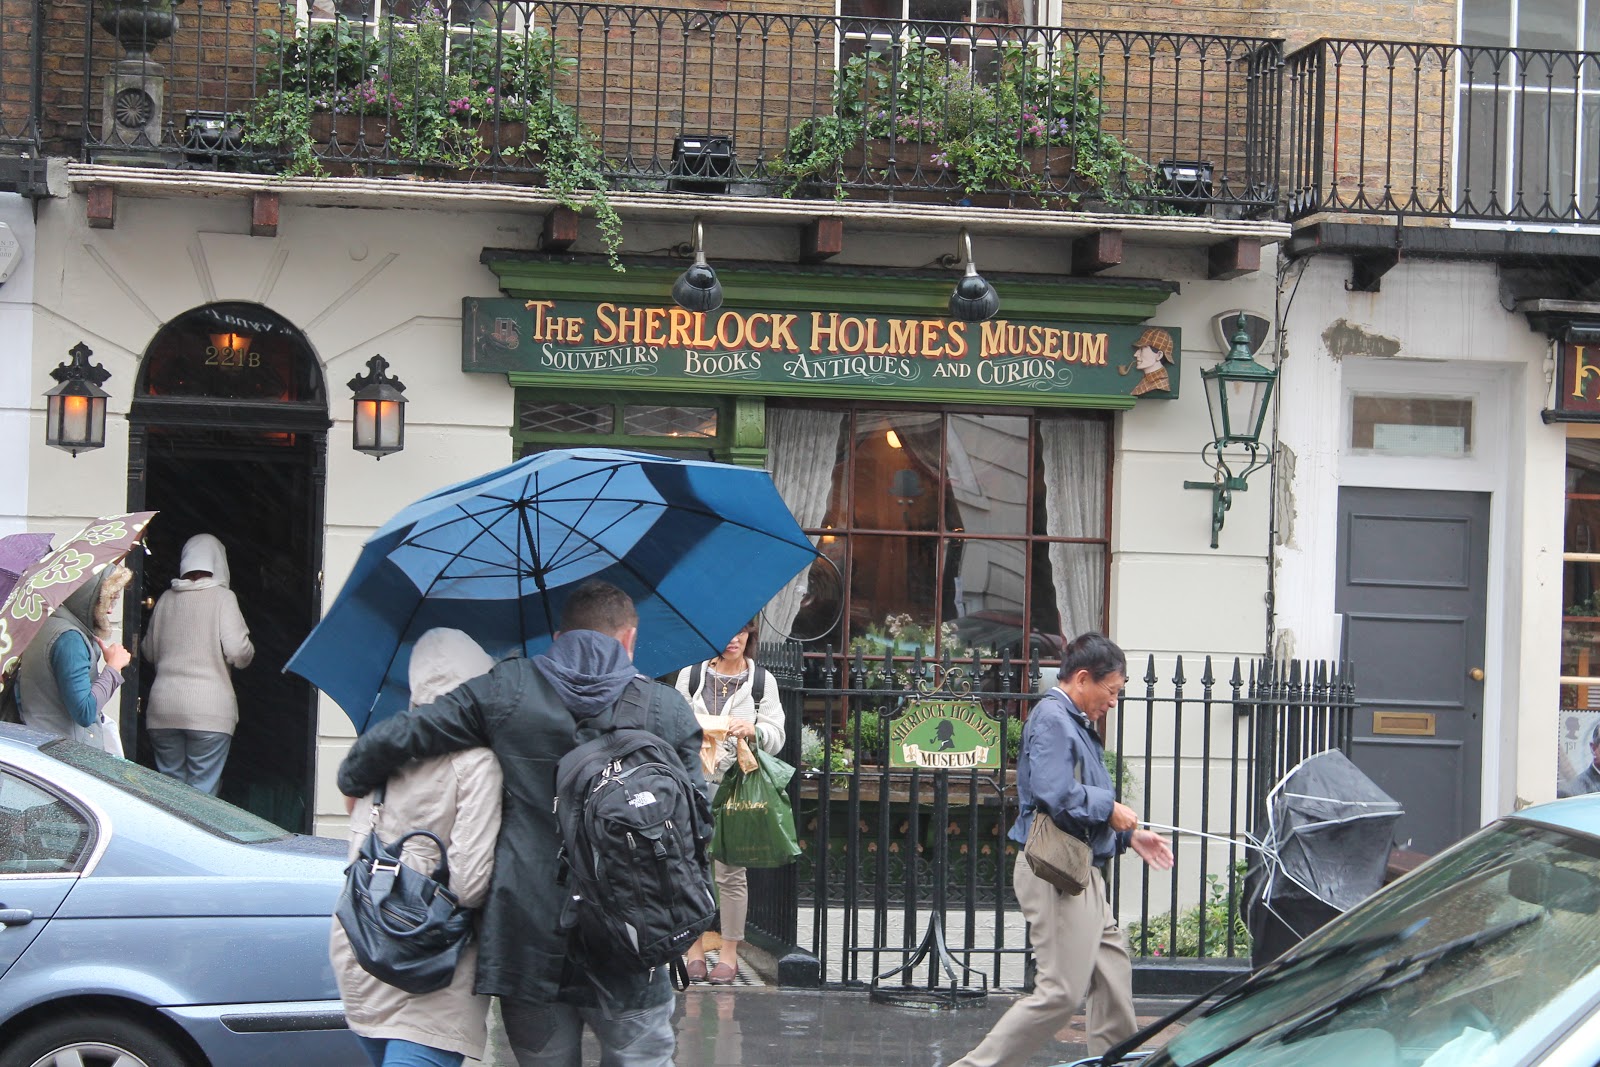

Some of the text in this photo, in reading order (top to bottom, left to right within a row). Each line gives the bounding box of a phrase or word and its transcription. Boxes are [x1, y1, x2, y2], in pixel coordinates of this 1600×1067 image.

[525, 299, 1109, 366] THE SHERLOCK HOLMES MUSEUM
[205, 346, 260, 367] 221B
[540, 343, 1056, 386] SOUVENIRS BOOKS ANTIQUES AND CURIOS
[891, 703, 1000, 748] SHERLOCK HOLMES
[920, 752, 976, 767] MUSEUM
